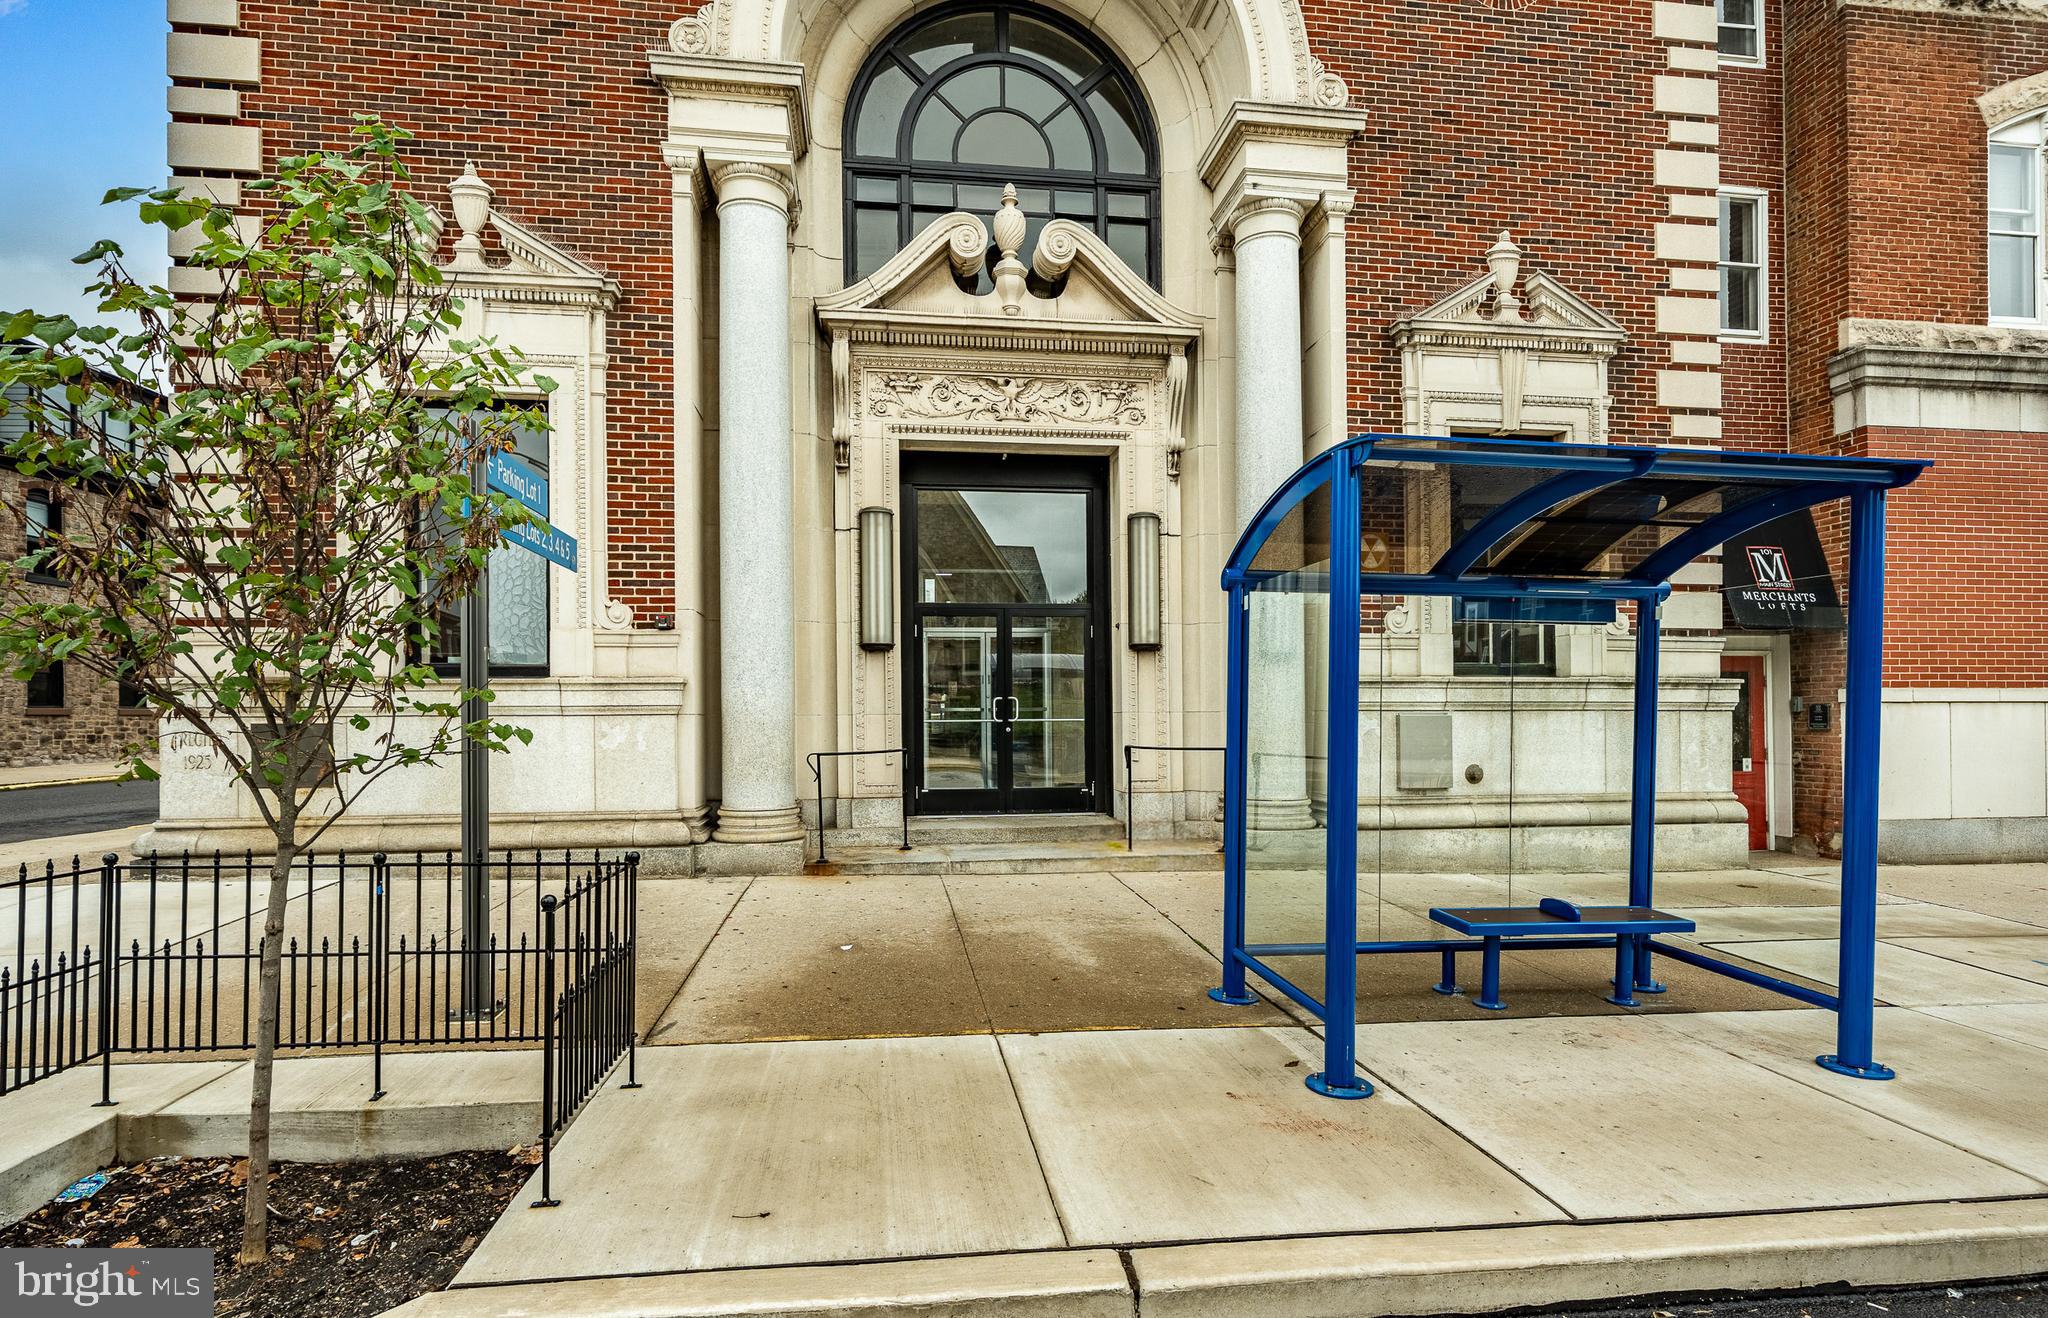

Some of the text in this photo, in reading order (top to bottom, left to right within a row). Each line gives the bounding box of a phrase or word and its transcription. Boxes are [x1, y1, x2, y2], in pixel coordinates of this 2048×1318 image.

[498, 458, 541, 505] Parking Lot 1
[526, 519, 541, 545] Lots
[566, 543, 571, 560] 5
[1750, 552, 1790, 582] M
[1742, 591, 1817, 602] MERCHANTS
[1757, 602, 1807, 611] LOFTS
[184, 754, 212, 770] 1925
